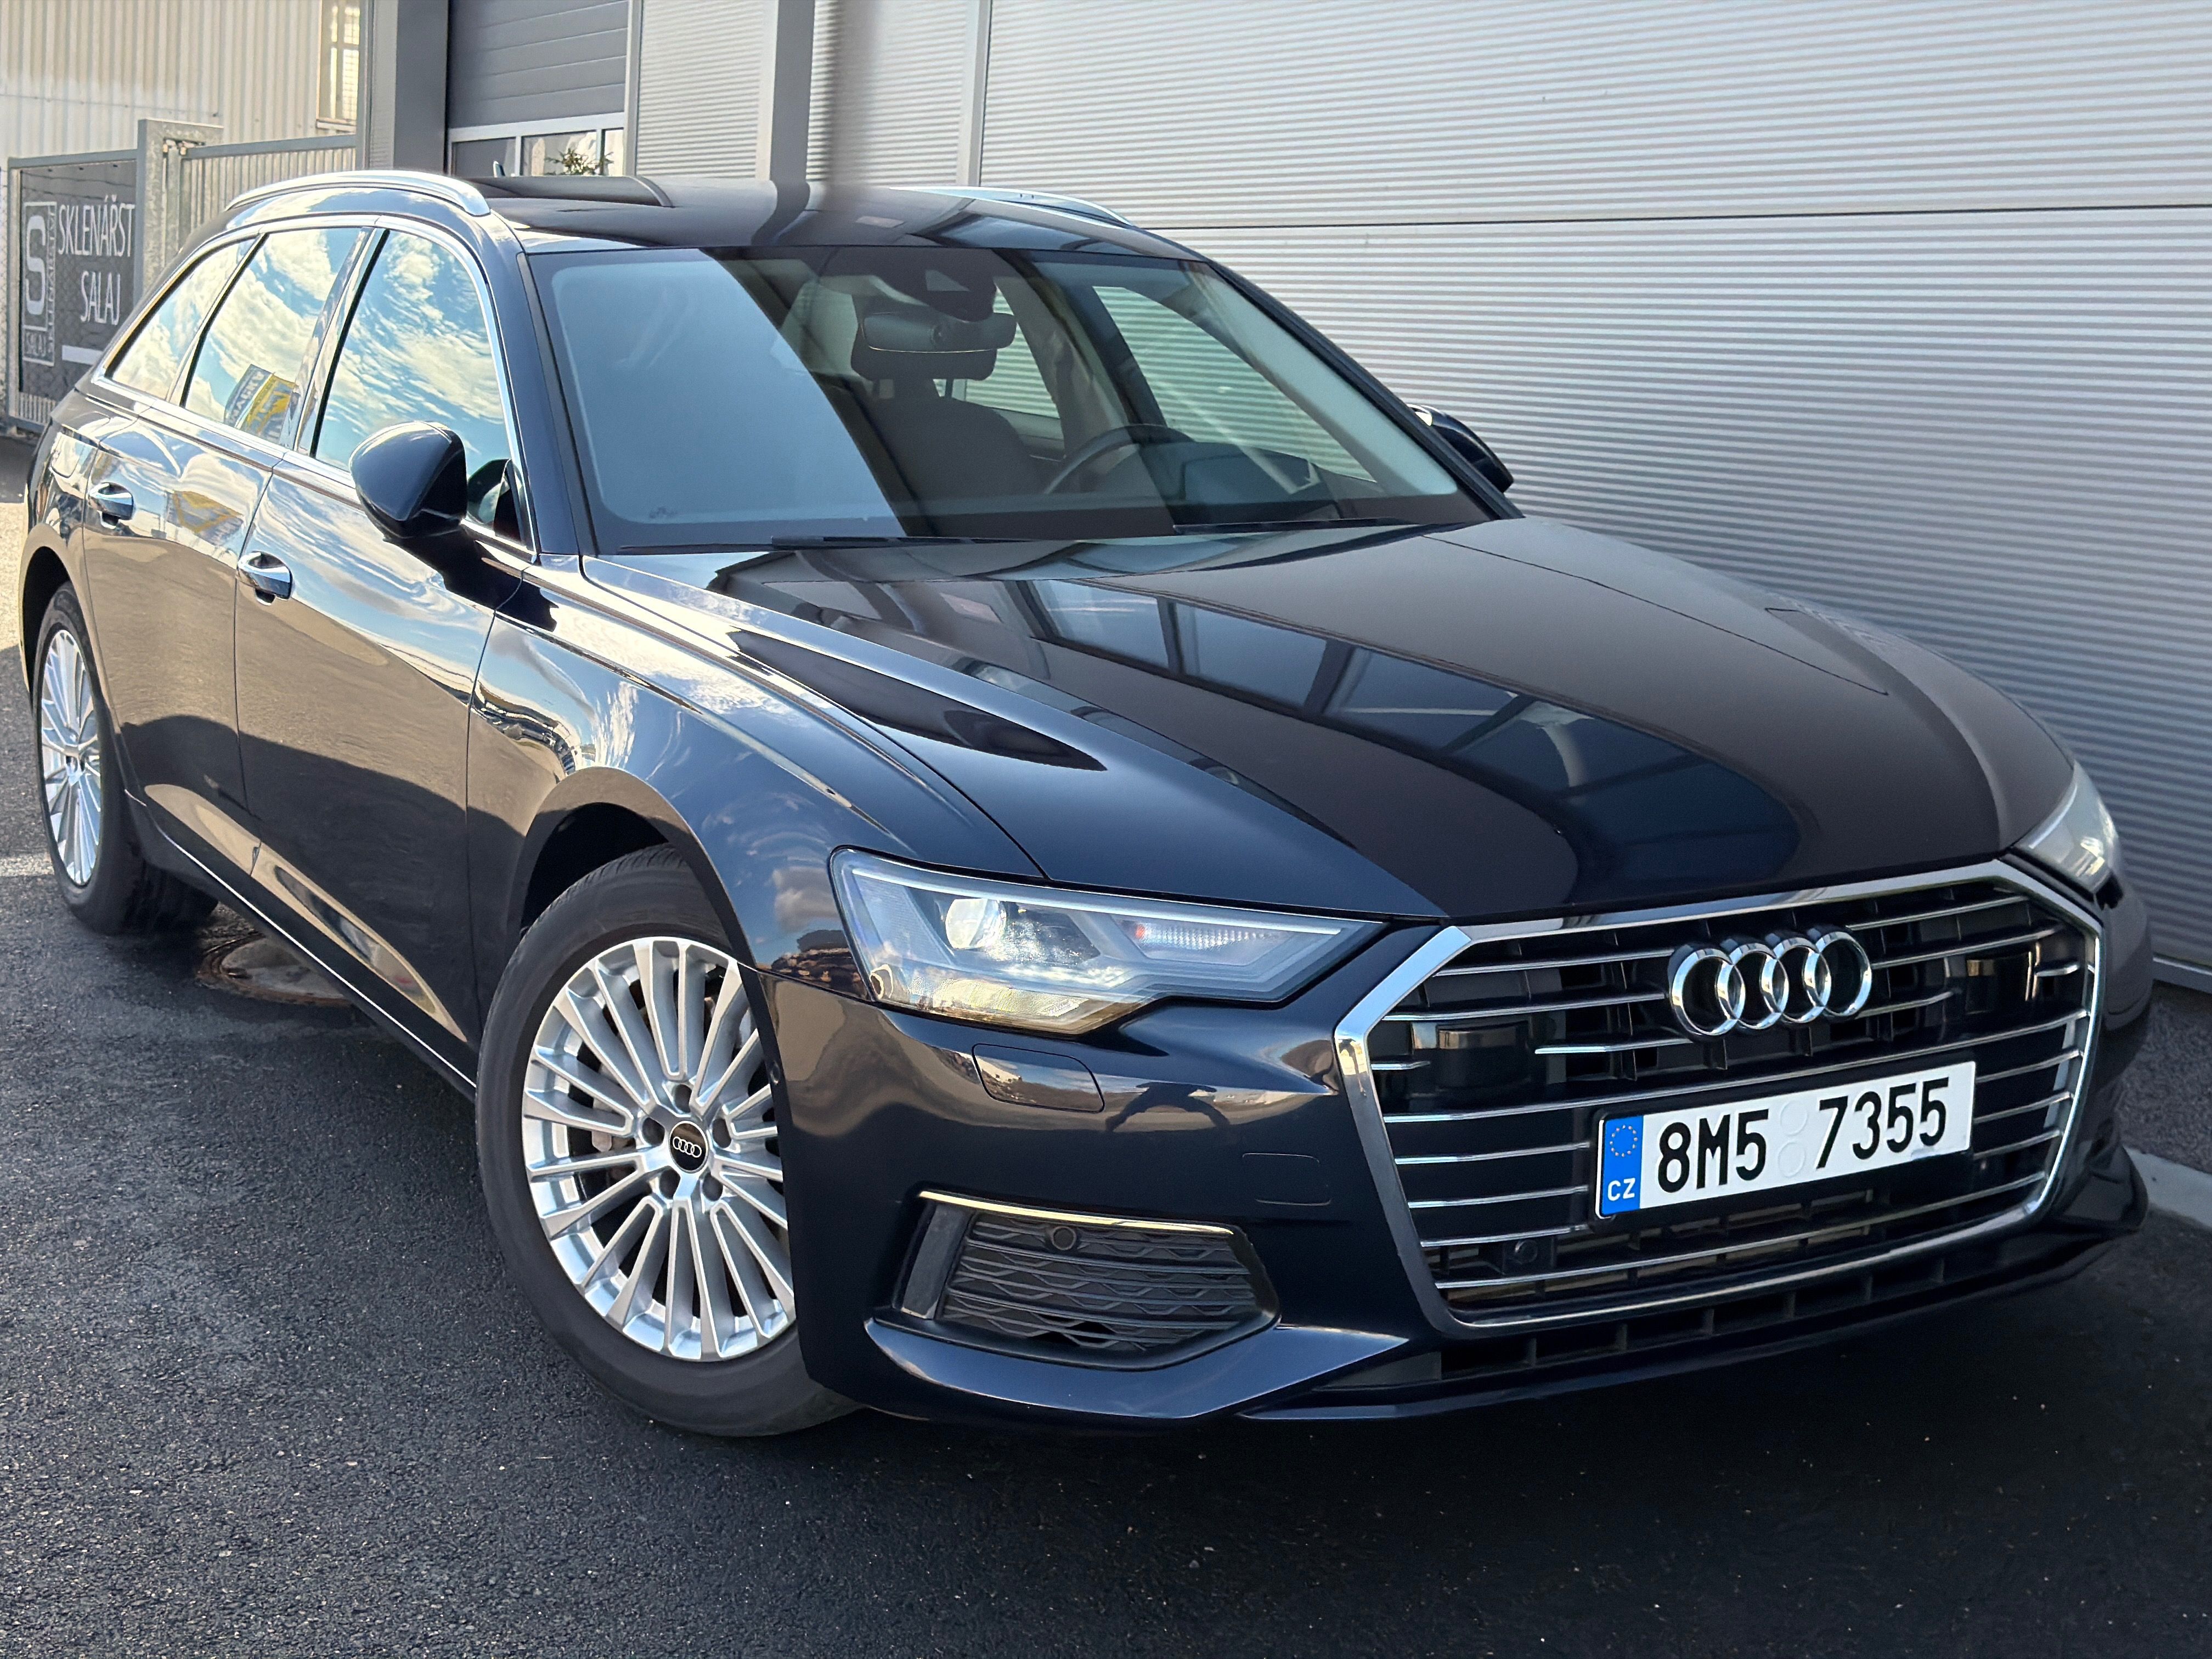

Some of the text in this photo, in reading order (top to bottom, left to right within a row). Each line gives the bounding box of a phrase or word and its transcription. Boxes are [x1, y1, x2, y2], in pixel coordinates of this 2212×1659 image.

[58, 195, 135, 257] SKLENÁŘST
[81, 271, 120, 325] SALAJ
[1657, 1077, 1949, 1193] 8M5 7355
[1607, 1177, 1636, 1201] CZ
